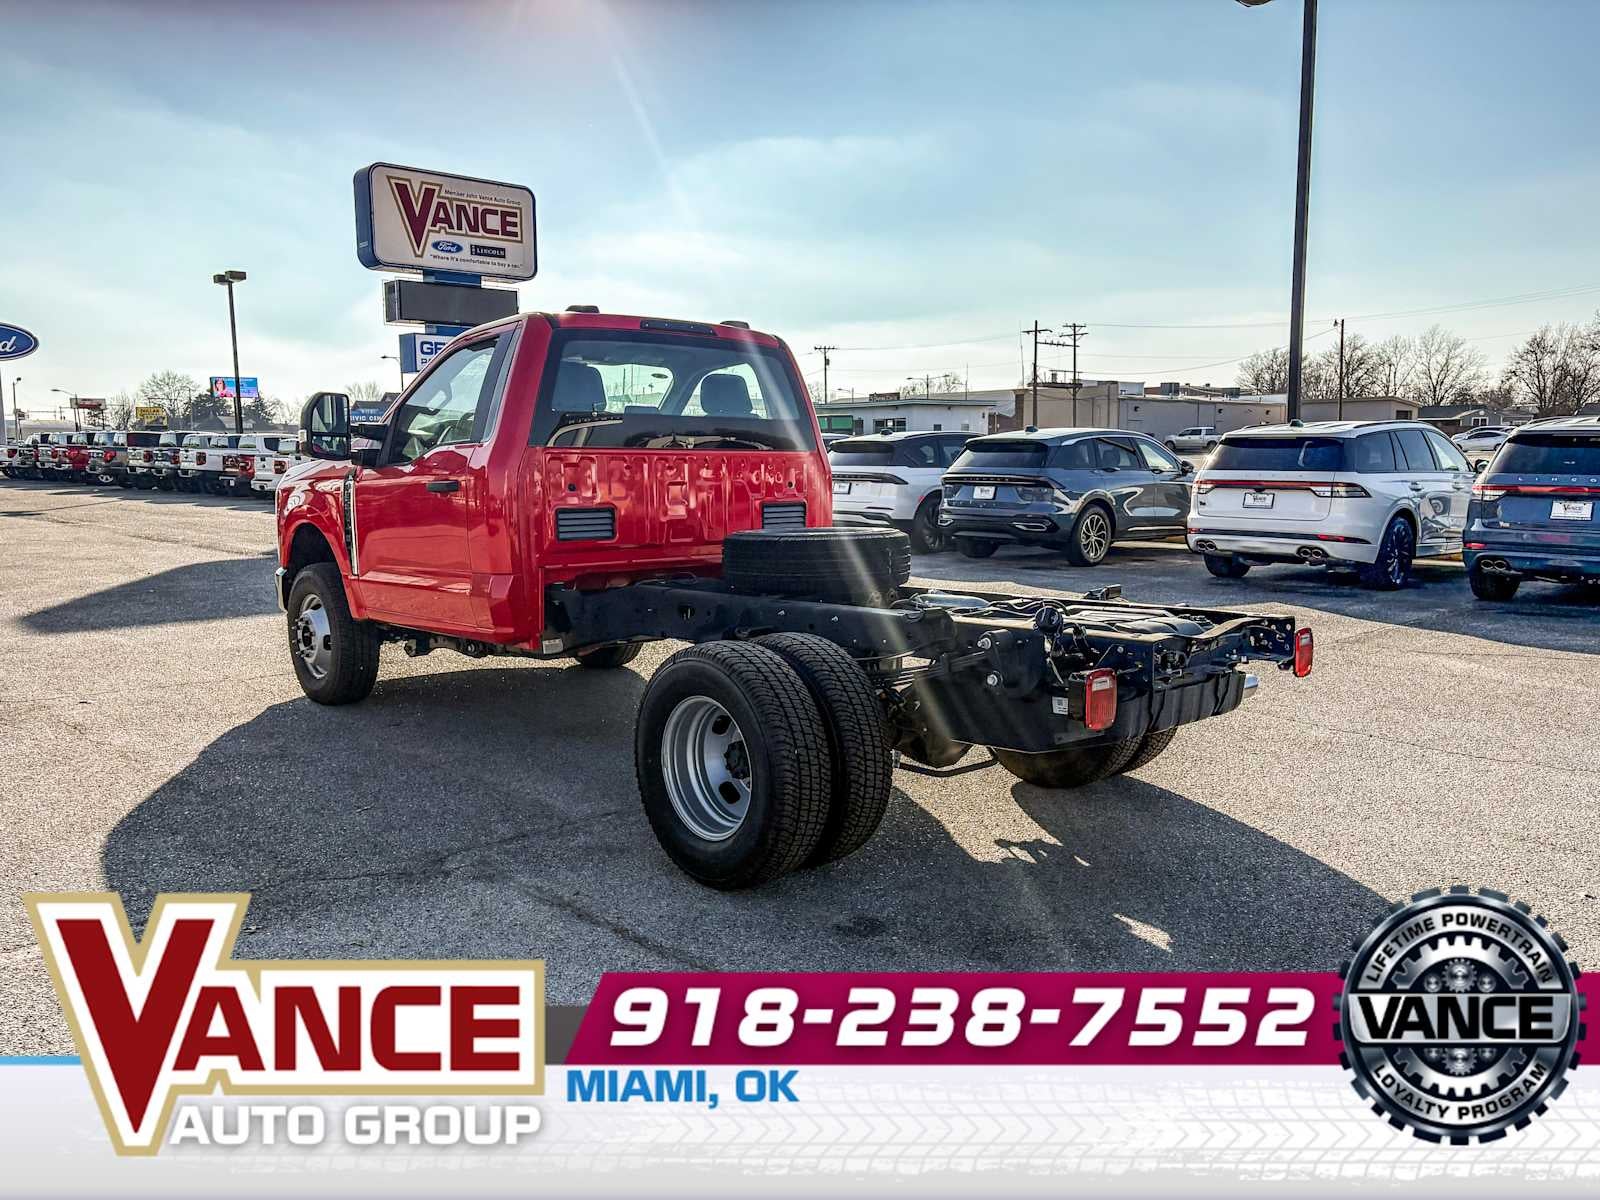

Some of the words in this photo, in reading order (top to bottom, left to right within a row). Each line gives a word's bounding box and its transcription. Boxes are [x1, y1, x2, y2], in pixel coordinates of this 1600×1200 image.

[393, 182, 519, 249] VANCE
[437, 241, 457, 252] Ford
[476, 247, 505, 256] LINCOLN
